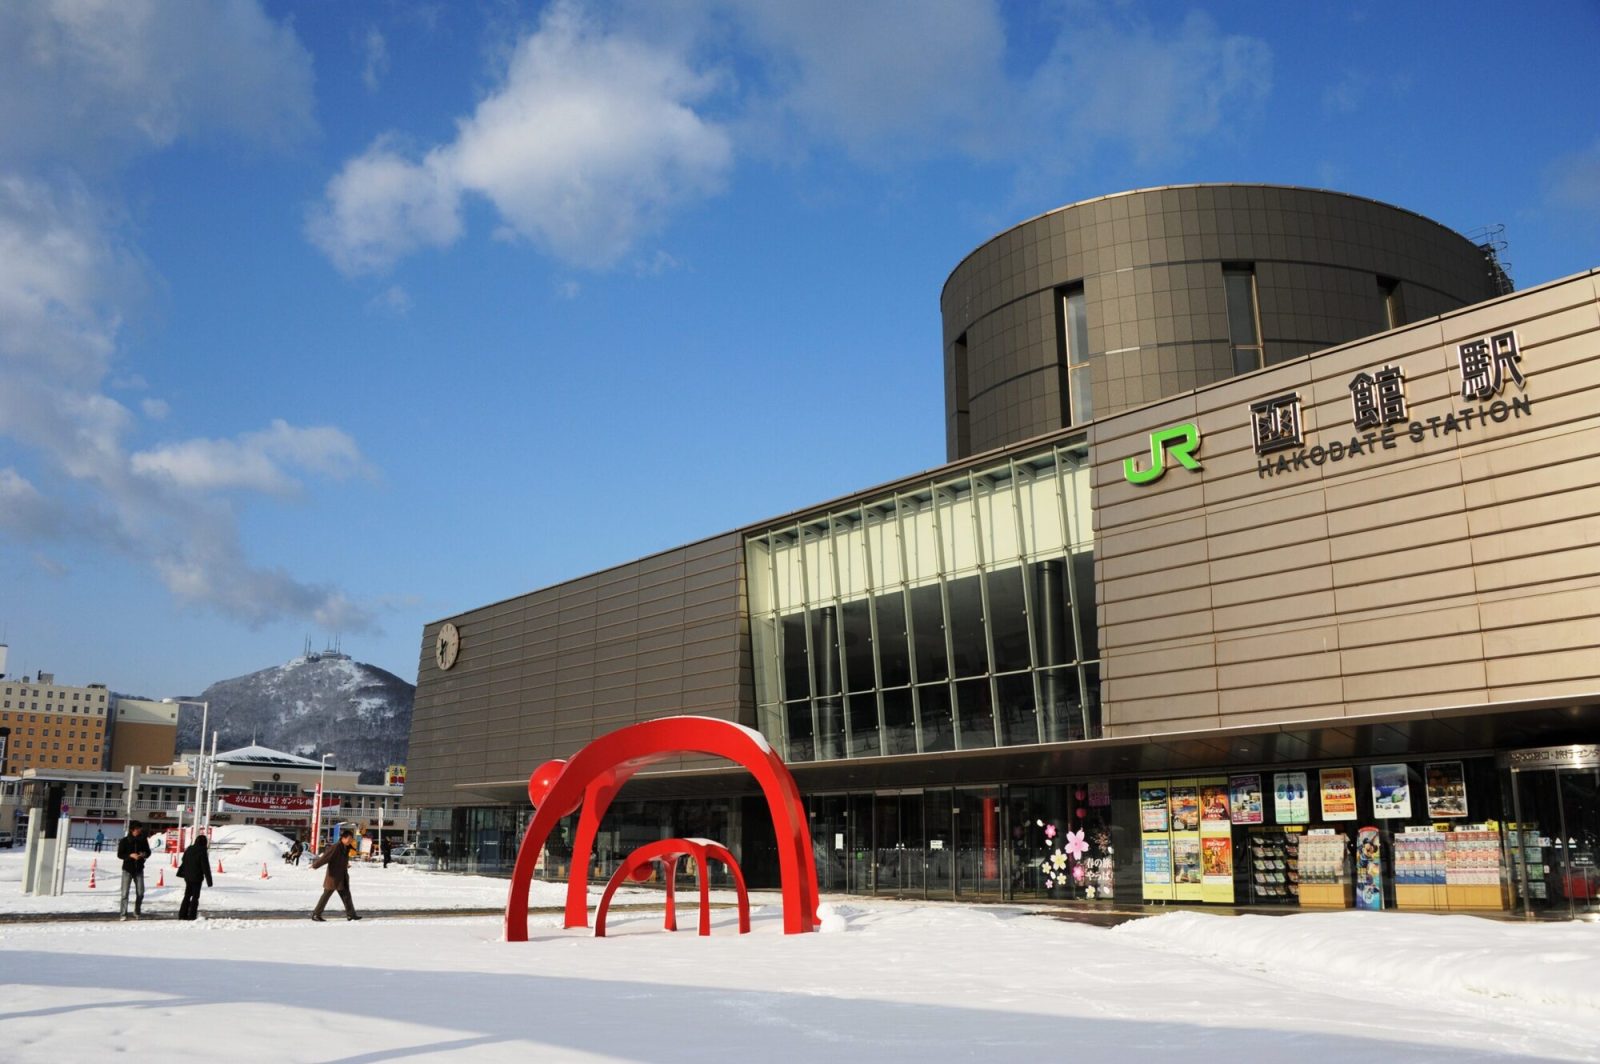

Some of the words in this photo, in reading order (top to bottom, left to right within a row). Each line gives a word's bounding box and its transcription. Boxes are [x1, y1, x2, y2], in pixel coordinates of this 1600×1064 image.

[1122, 423, 1204, 485] JR
[1258, 426, 1396, 479] HAKODATE
[1408, 393, 1533, 443] STATION
